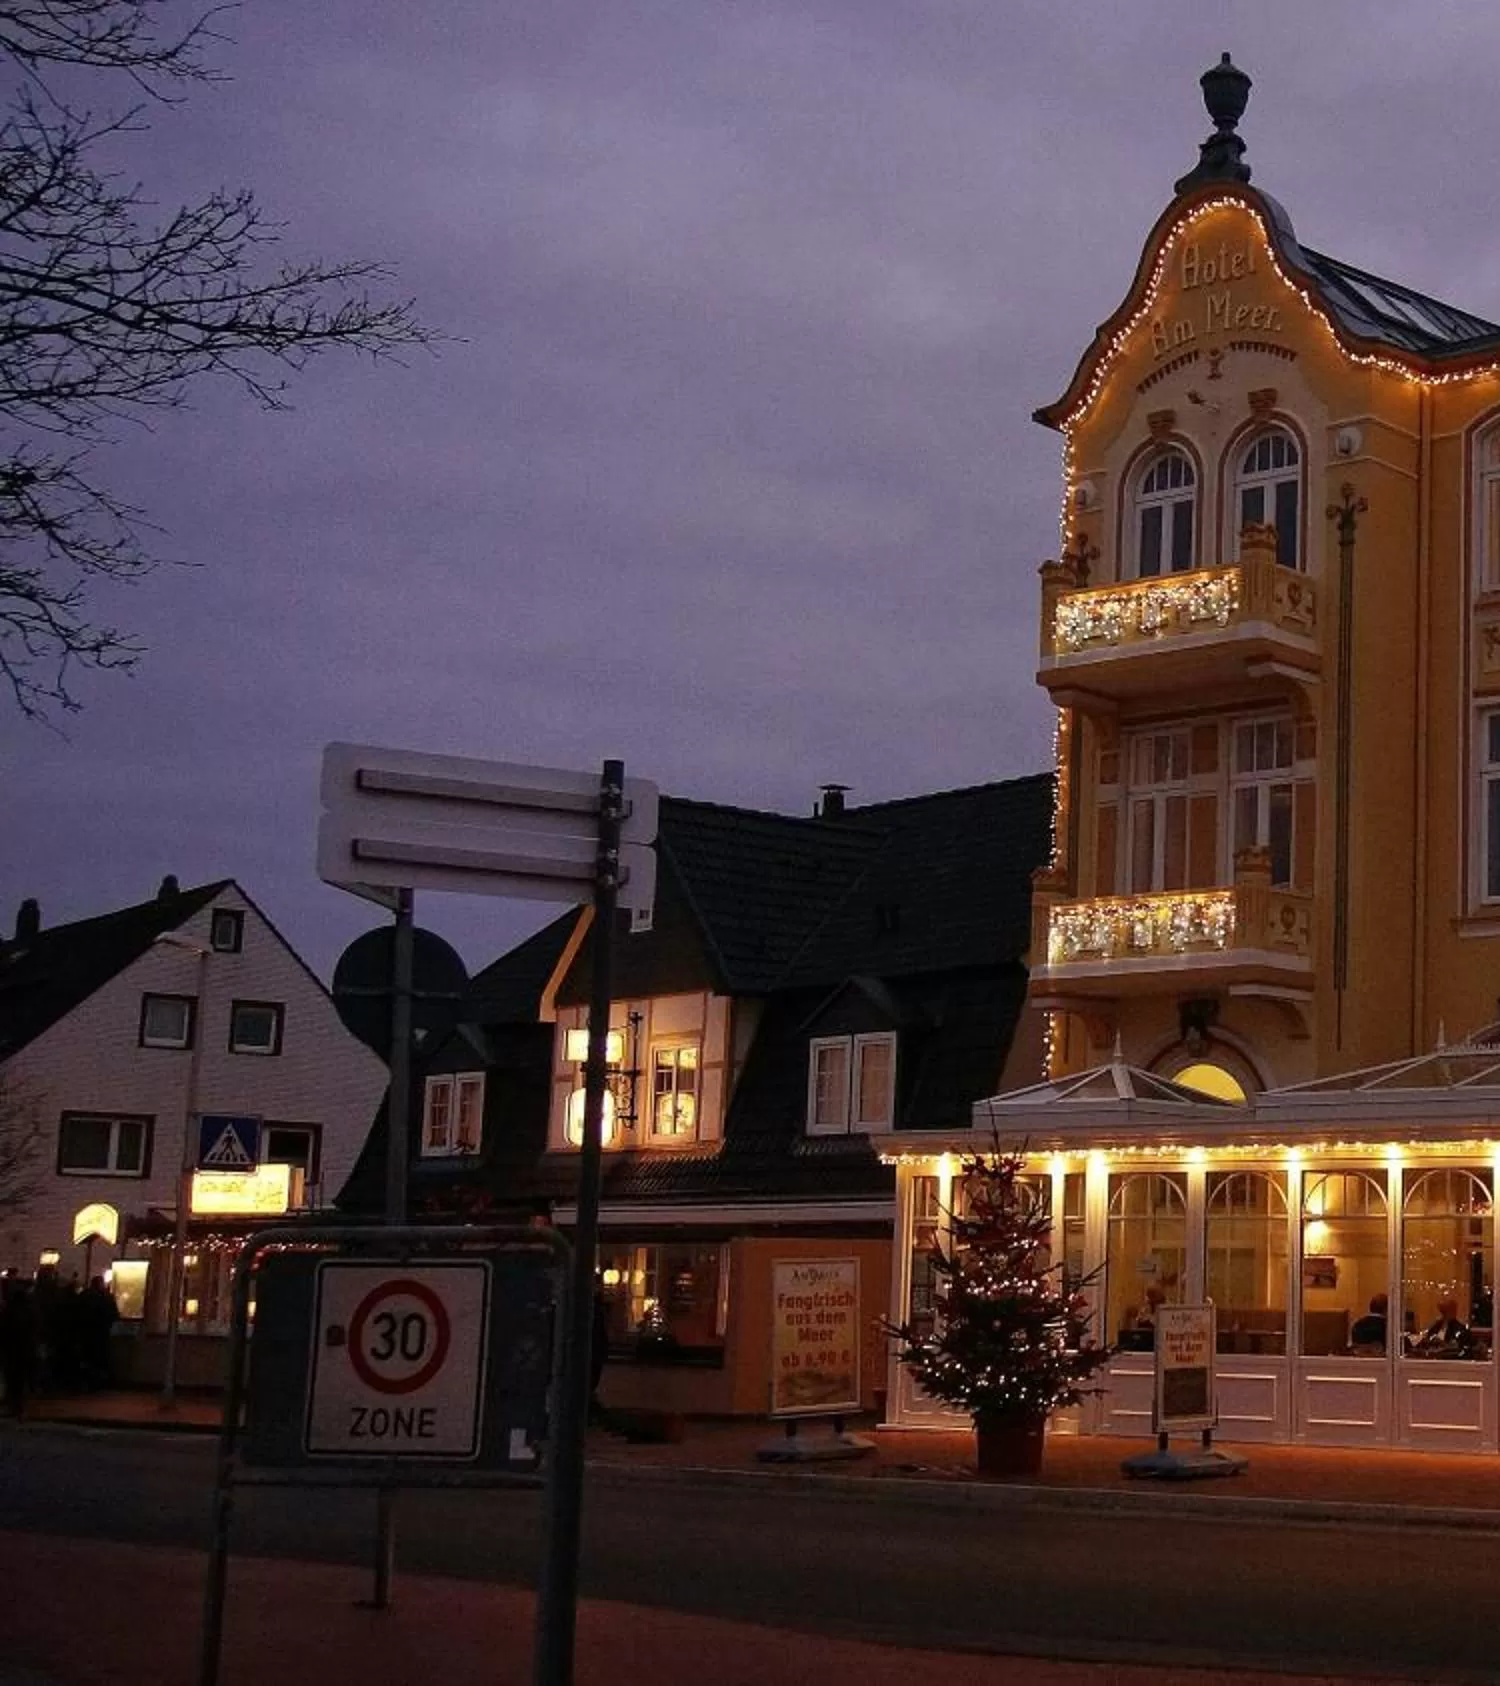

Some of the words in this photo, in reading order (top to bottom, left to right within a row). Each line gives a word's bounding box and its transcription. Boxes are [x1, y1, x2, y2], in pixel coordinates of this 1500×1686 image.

[1181, 236, 1256, 290] Hotel
[778, 1291, 853, 1310] Fangfrisch
[816, 1309, 846, 1324] dem
[370, 1311, 427, 1361] 30
[798, 1328, 834, 1342] Meer
[782, 1352, 800, 1367] ab
[349, 1407, 437, 1437] ZONE
